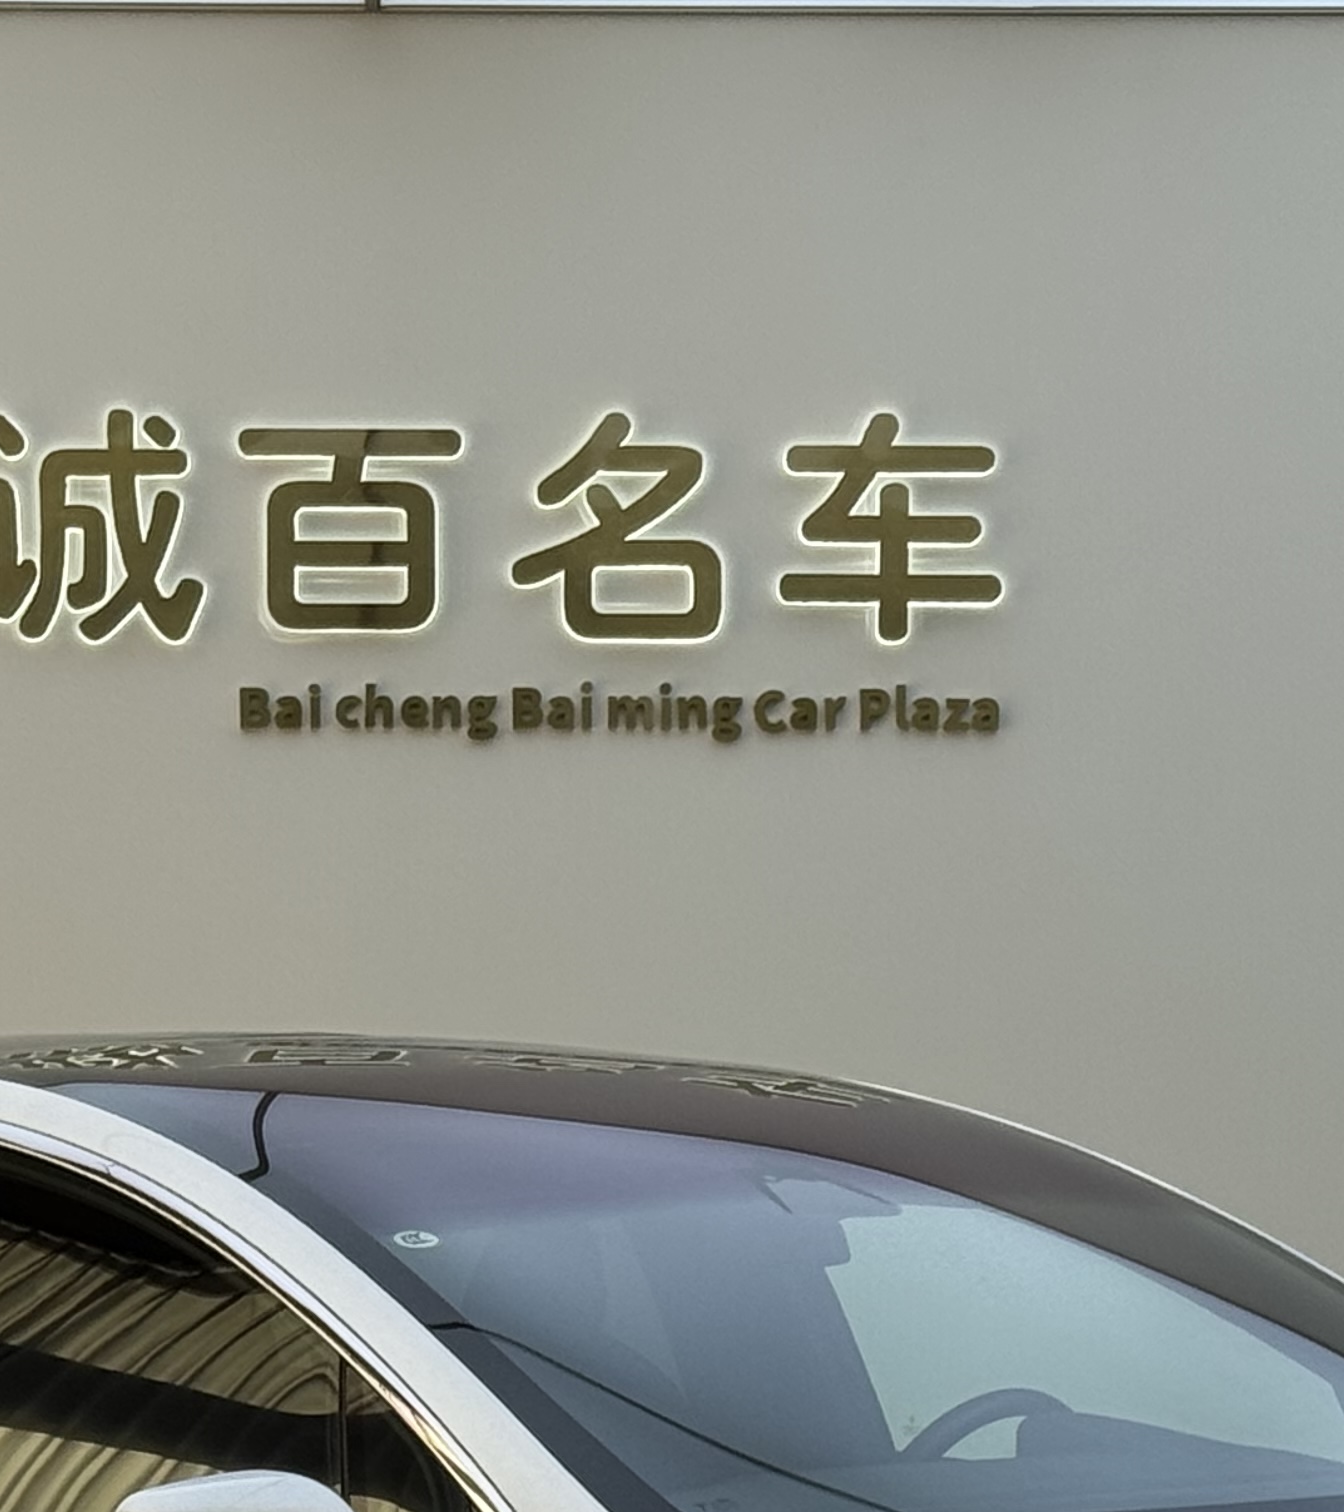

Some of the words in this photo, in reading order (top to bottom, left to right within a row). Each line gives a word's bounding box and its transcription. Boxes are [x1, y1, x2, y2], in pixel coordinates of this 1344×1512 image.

[239, 683, 321, 731] Bai
[335, 683, 498, 741] cheng
[511, 681, 595, 731] Bai
[607, 682, 744, 744] ming
[753, 689, 848, 734] Car
[858, 684, 1001, 733] Plaza
